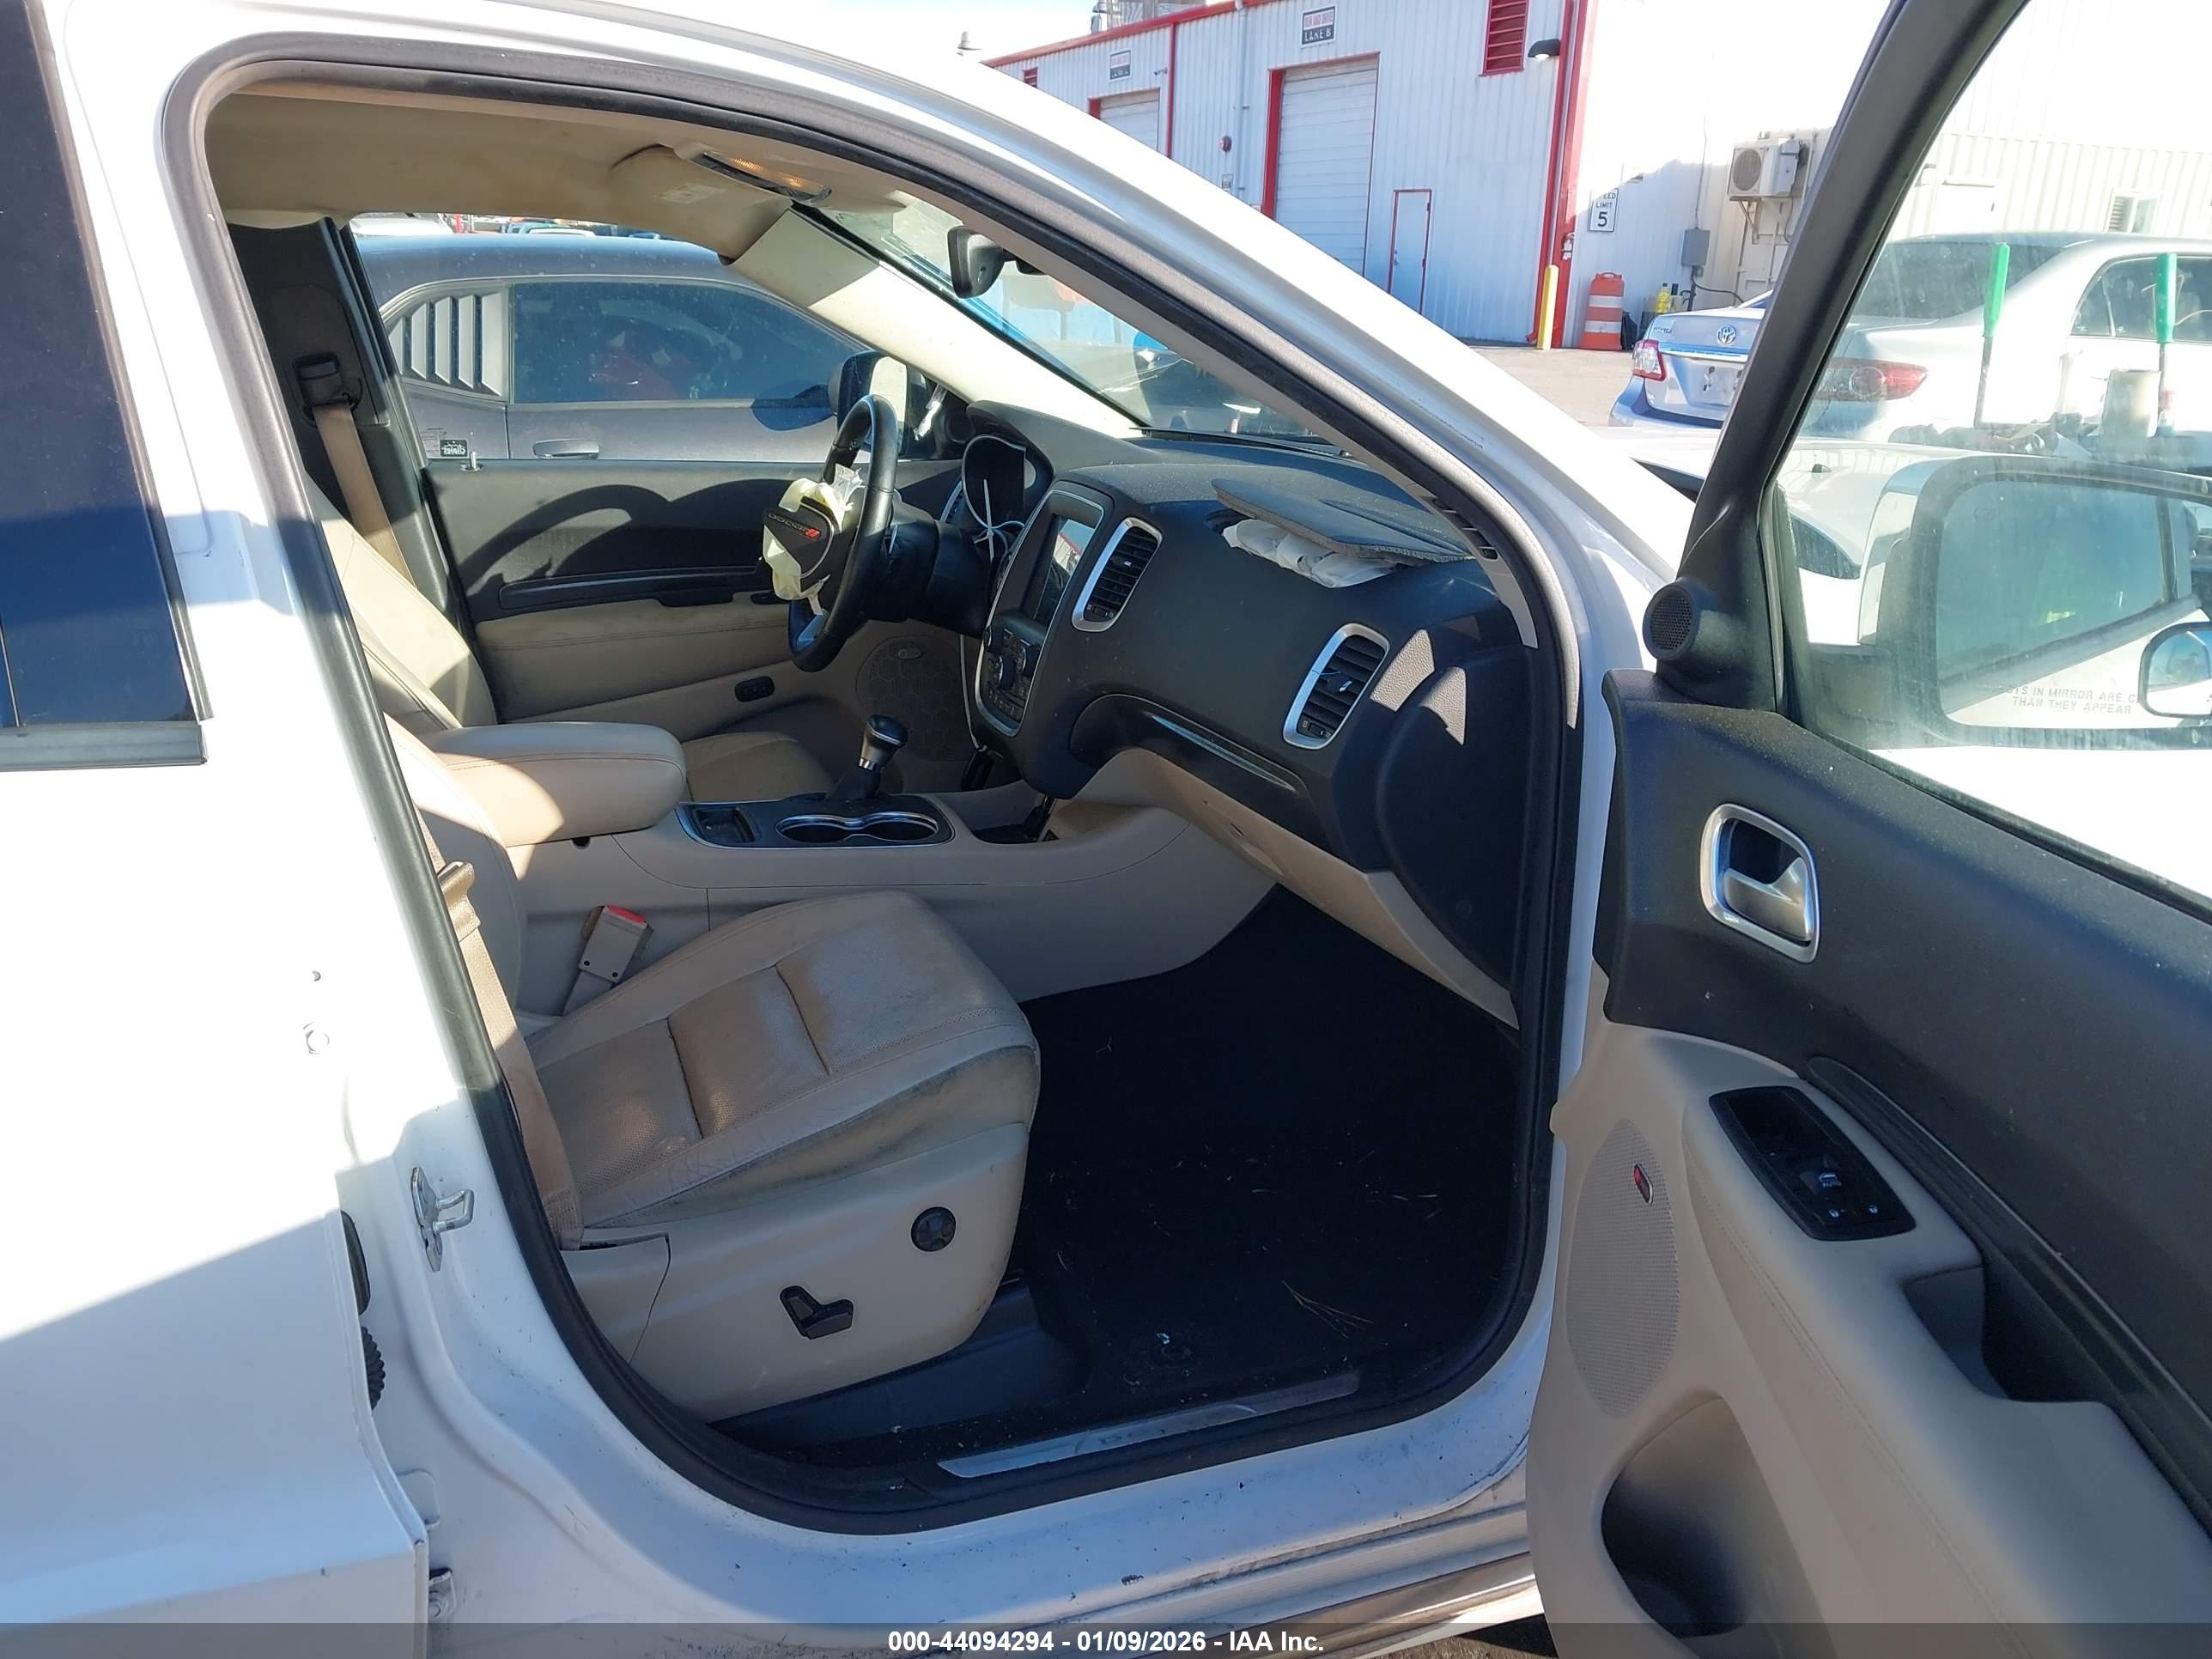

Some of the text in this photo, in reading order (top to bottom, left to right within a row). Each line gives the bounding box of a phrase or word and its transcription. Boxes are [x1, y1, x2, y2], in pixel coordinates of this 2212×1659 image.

[1305, 28, 1323, 41] LANE
[1597, 211, 1607, 227] 5
[2033, 686, 2044, 696] IN
[2048, 688, 2094, 700] MIRROR
[2099, 692, 2123, 702] ARE
[2013, 696, 2131, 714] THAN THEY APPEAR
